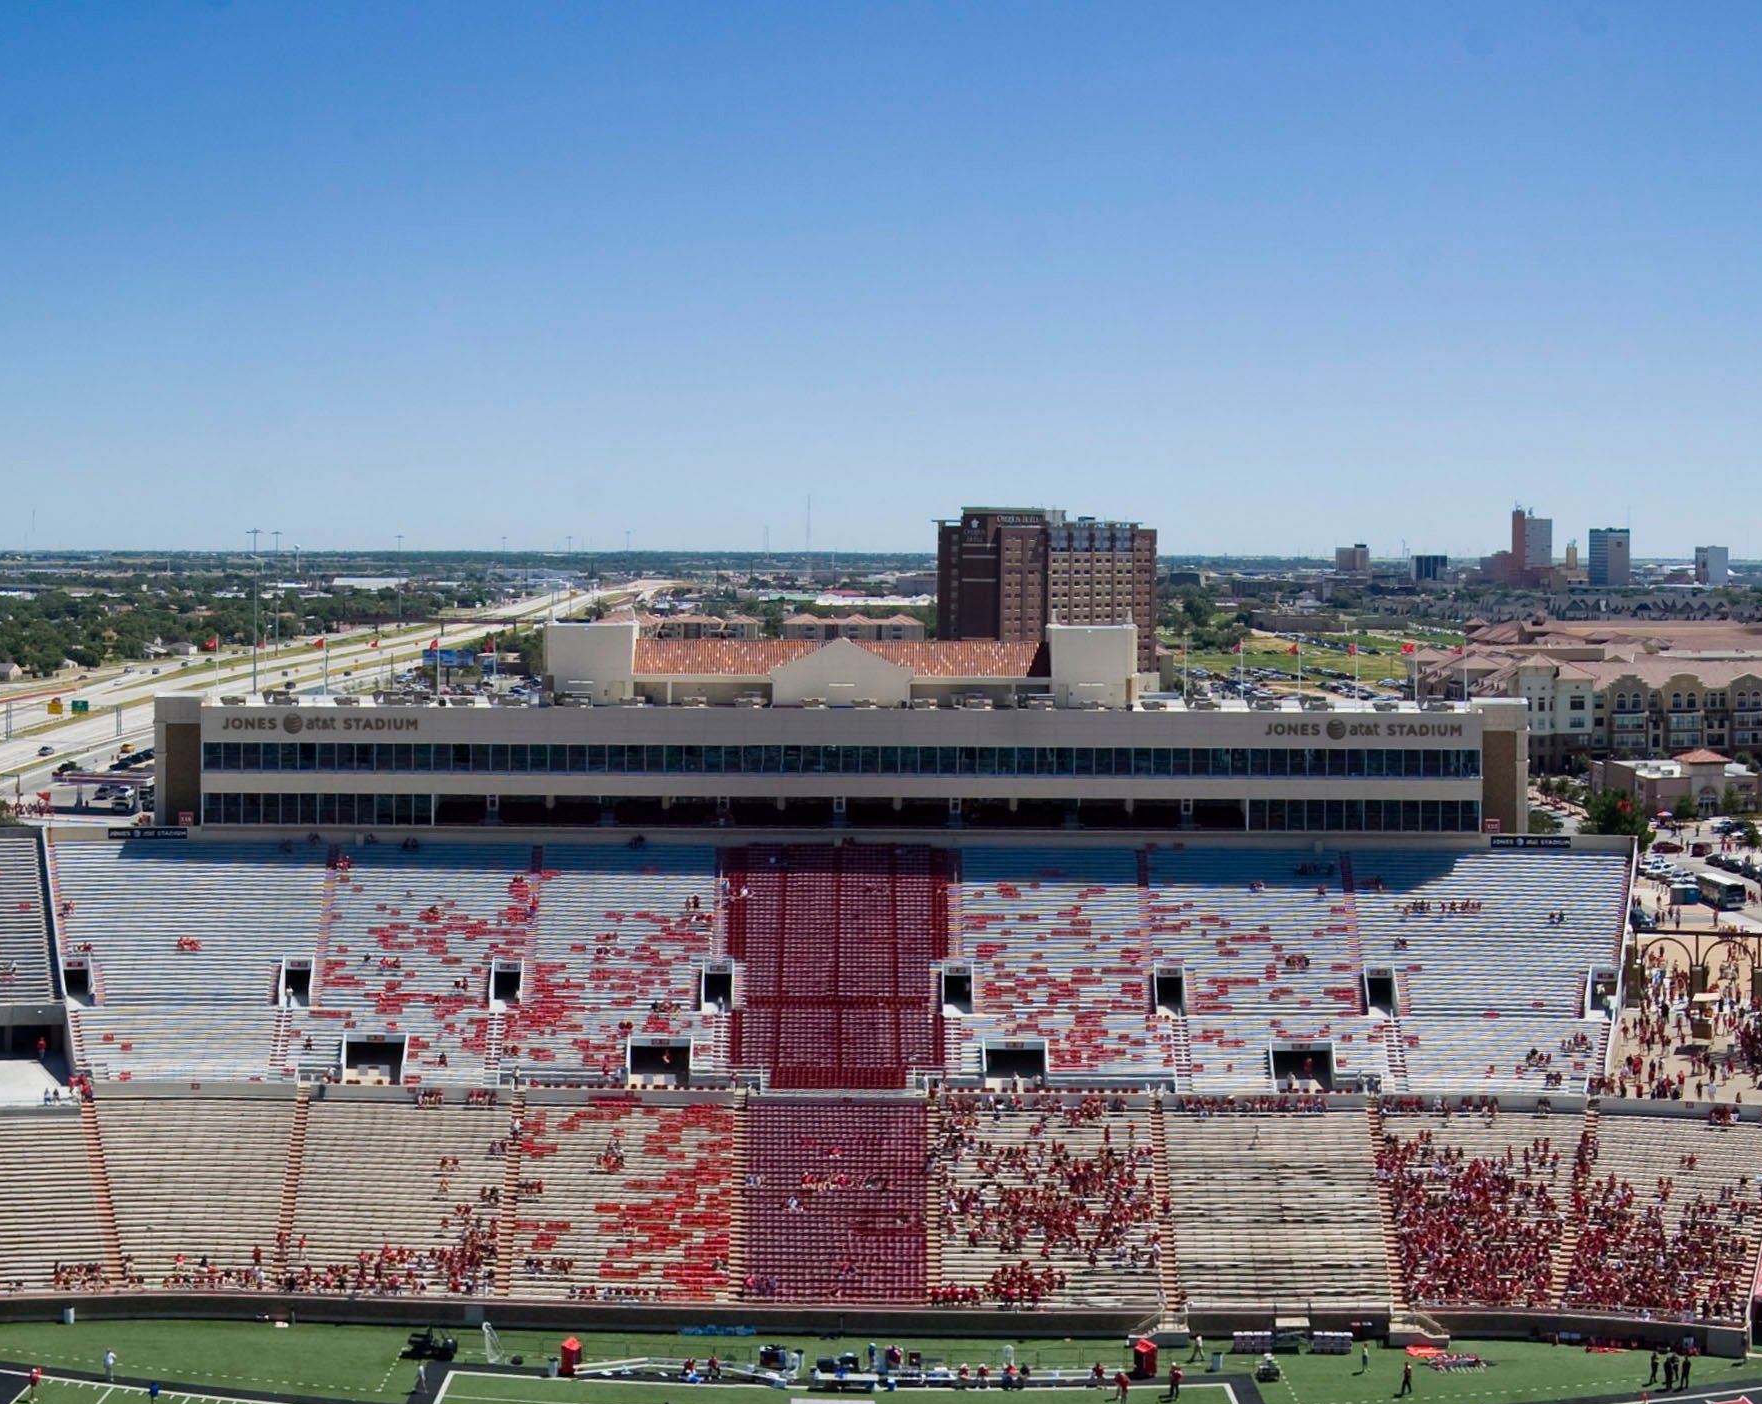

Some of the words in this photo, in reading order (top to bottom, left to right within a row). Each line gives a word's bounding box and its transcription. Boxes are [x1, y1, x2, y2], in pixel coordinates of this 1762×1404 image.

[222, 717, 278, 730] JONES
[343, 717, 419, 731] STADIUM
[1264, 722, 1321, 736] JONES
[1386, 722, 1464, 737] STADIUM
[1540, 838, 1571, 847] STADIUM
